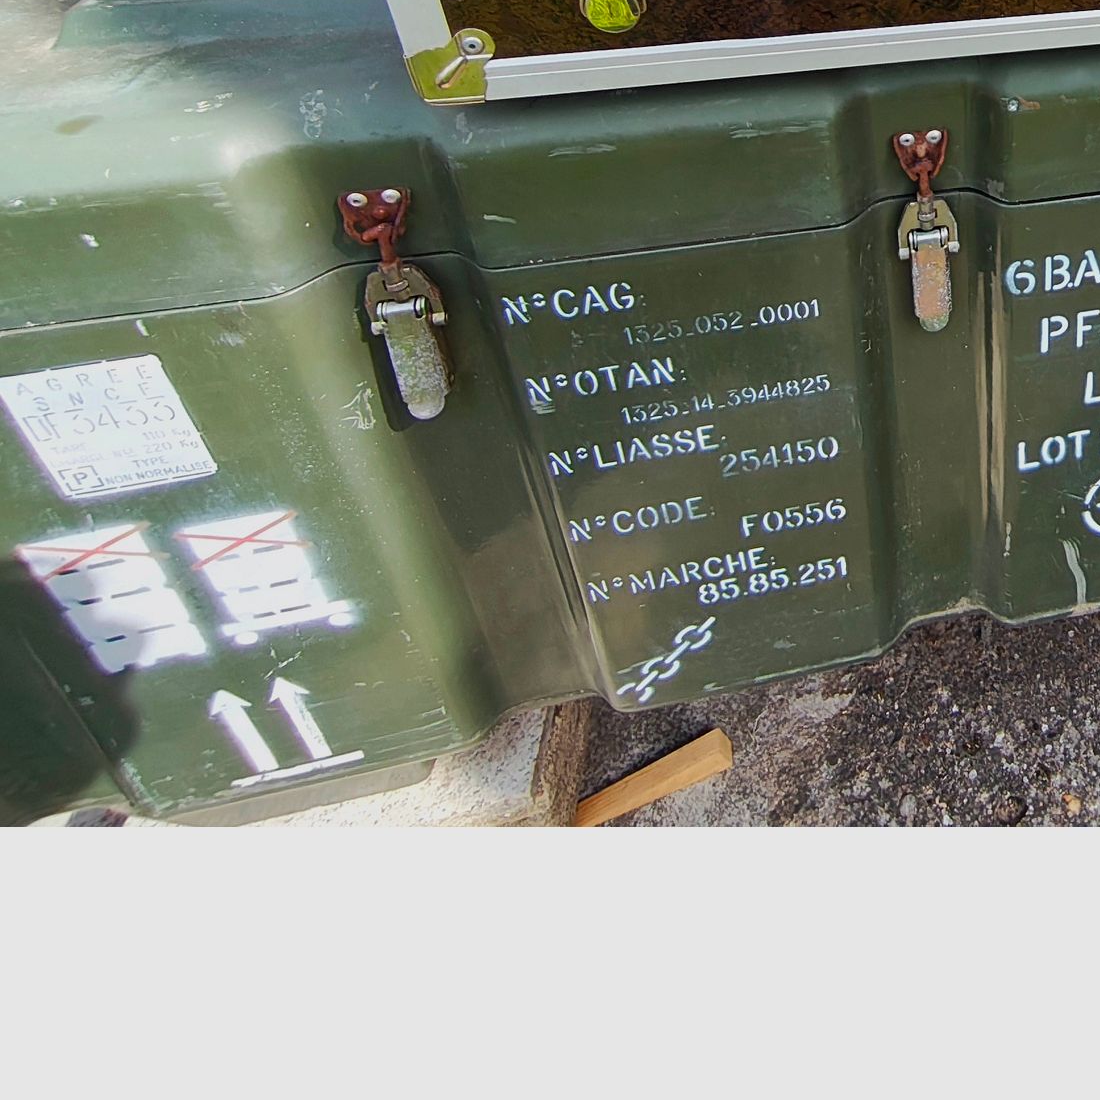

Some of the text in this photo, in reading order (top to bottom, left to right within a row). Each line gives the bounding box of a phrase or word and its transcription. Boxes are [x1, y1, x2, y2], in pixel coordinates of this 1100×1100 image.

[720, 435, 839, 477] 254150
[1018, 430, 1091, 471] LOT
[105, 473, 133, 486] NON
[699, 556, 847, 604] 85.85.251
